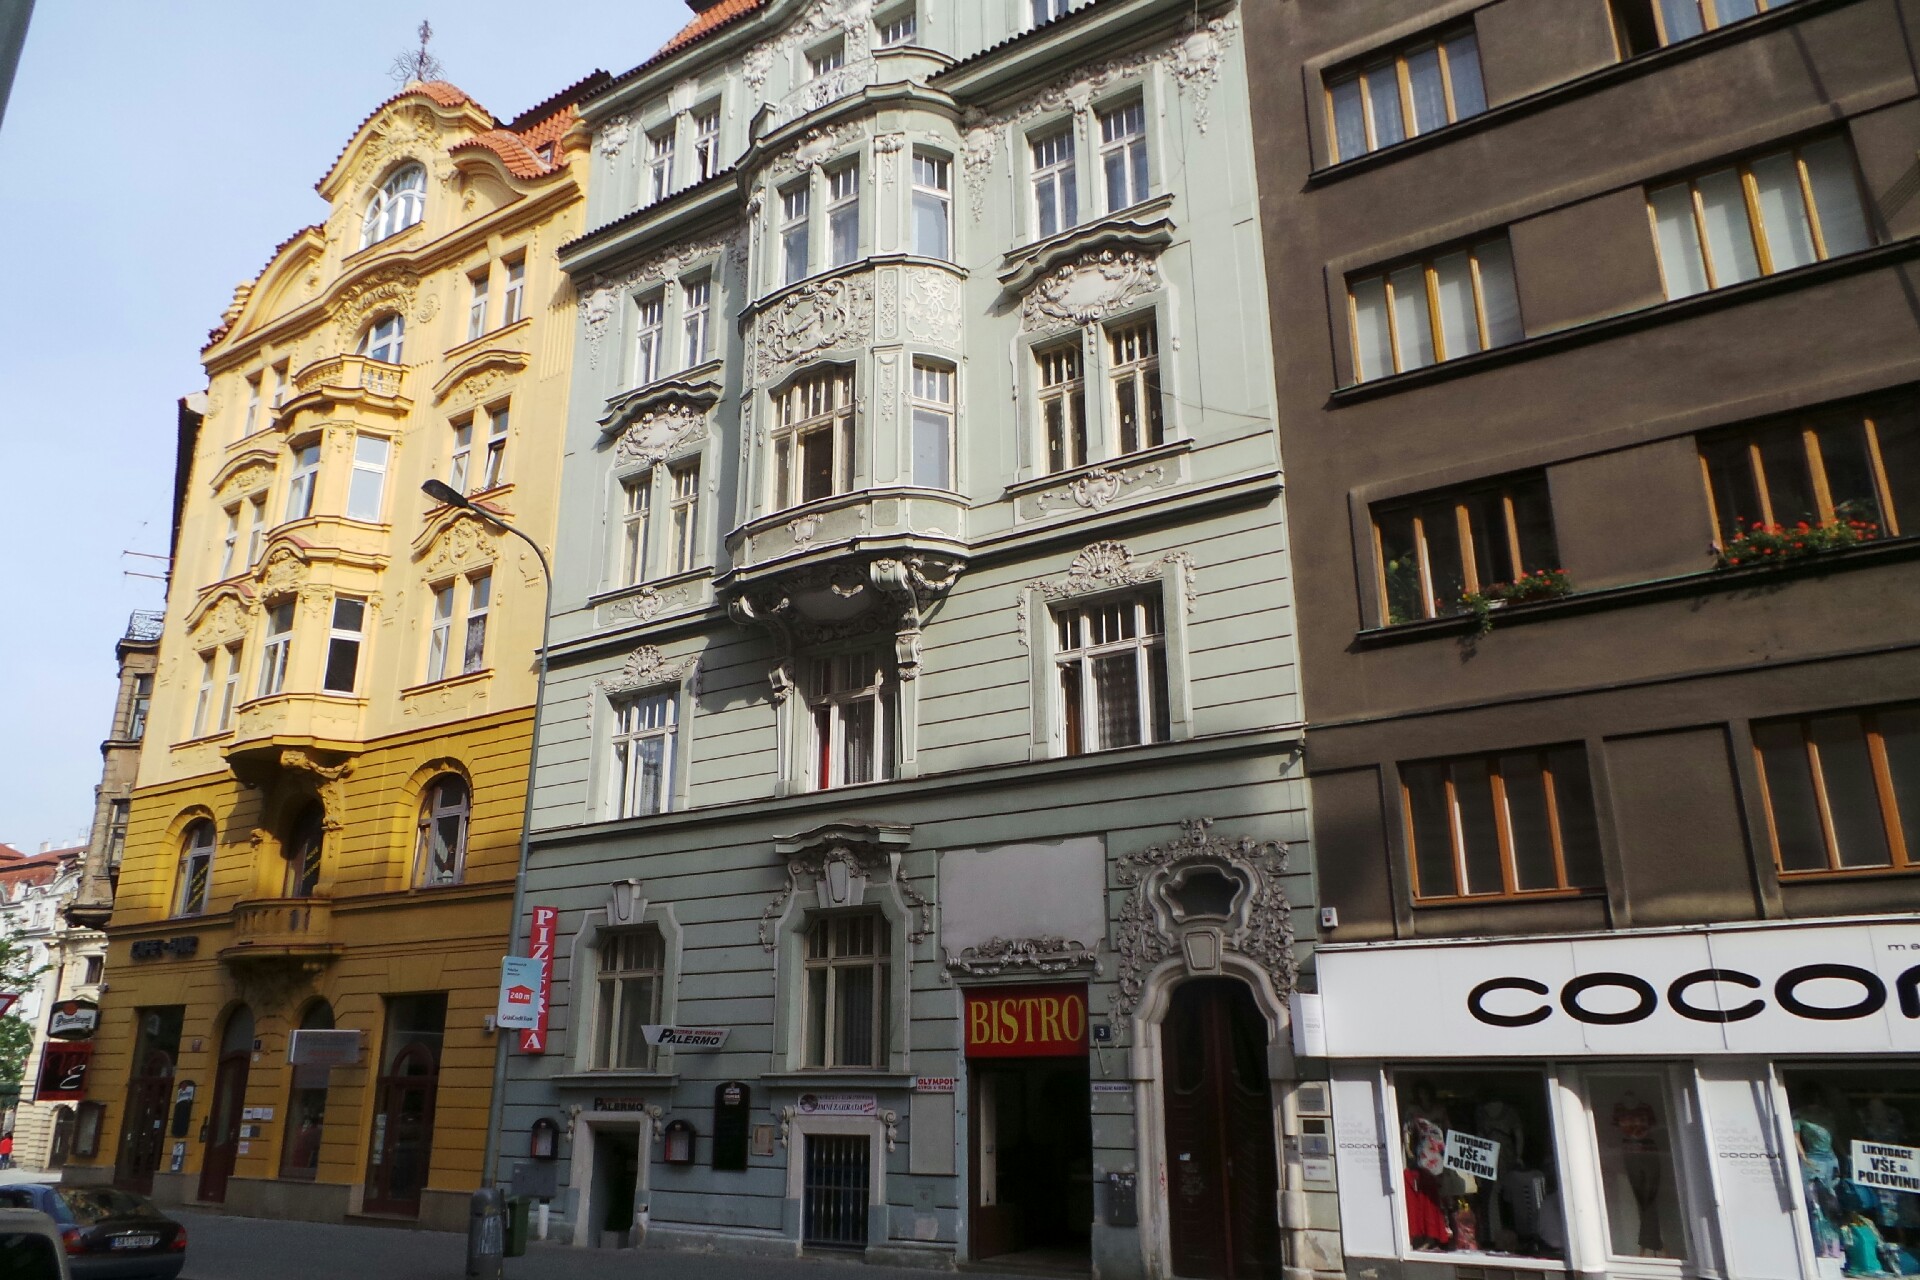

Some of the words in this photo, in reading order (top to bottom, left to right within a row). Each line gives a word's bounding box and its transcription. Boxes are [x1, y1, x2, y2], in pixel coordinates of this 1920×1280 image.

[510, 992, 523, 1000] 240
[969, 995, 1086, 1044] BISTRO
[658, 1028, 720, 1046] PALERMO
[1100, 1028, 1105, 1037] 3
[918, 1078, 954, 1086] OLYMPOS
[593, 1097, 644, 1111] PALERMO
[1454, 1134, 1493, 1151] LIKVIDACE
[1459, 1145, 1479, 1162] VŠE
[1862, 1144, 1914, 1161] LIKVIDACE
[1447, 1155, 1494, 1178] POLOVINU
[1870, 1156, 1897, 1174] VŠE
[1857, 1169, 1920, 1190] POLOVINU
